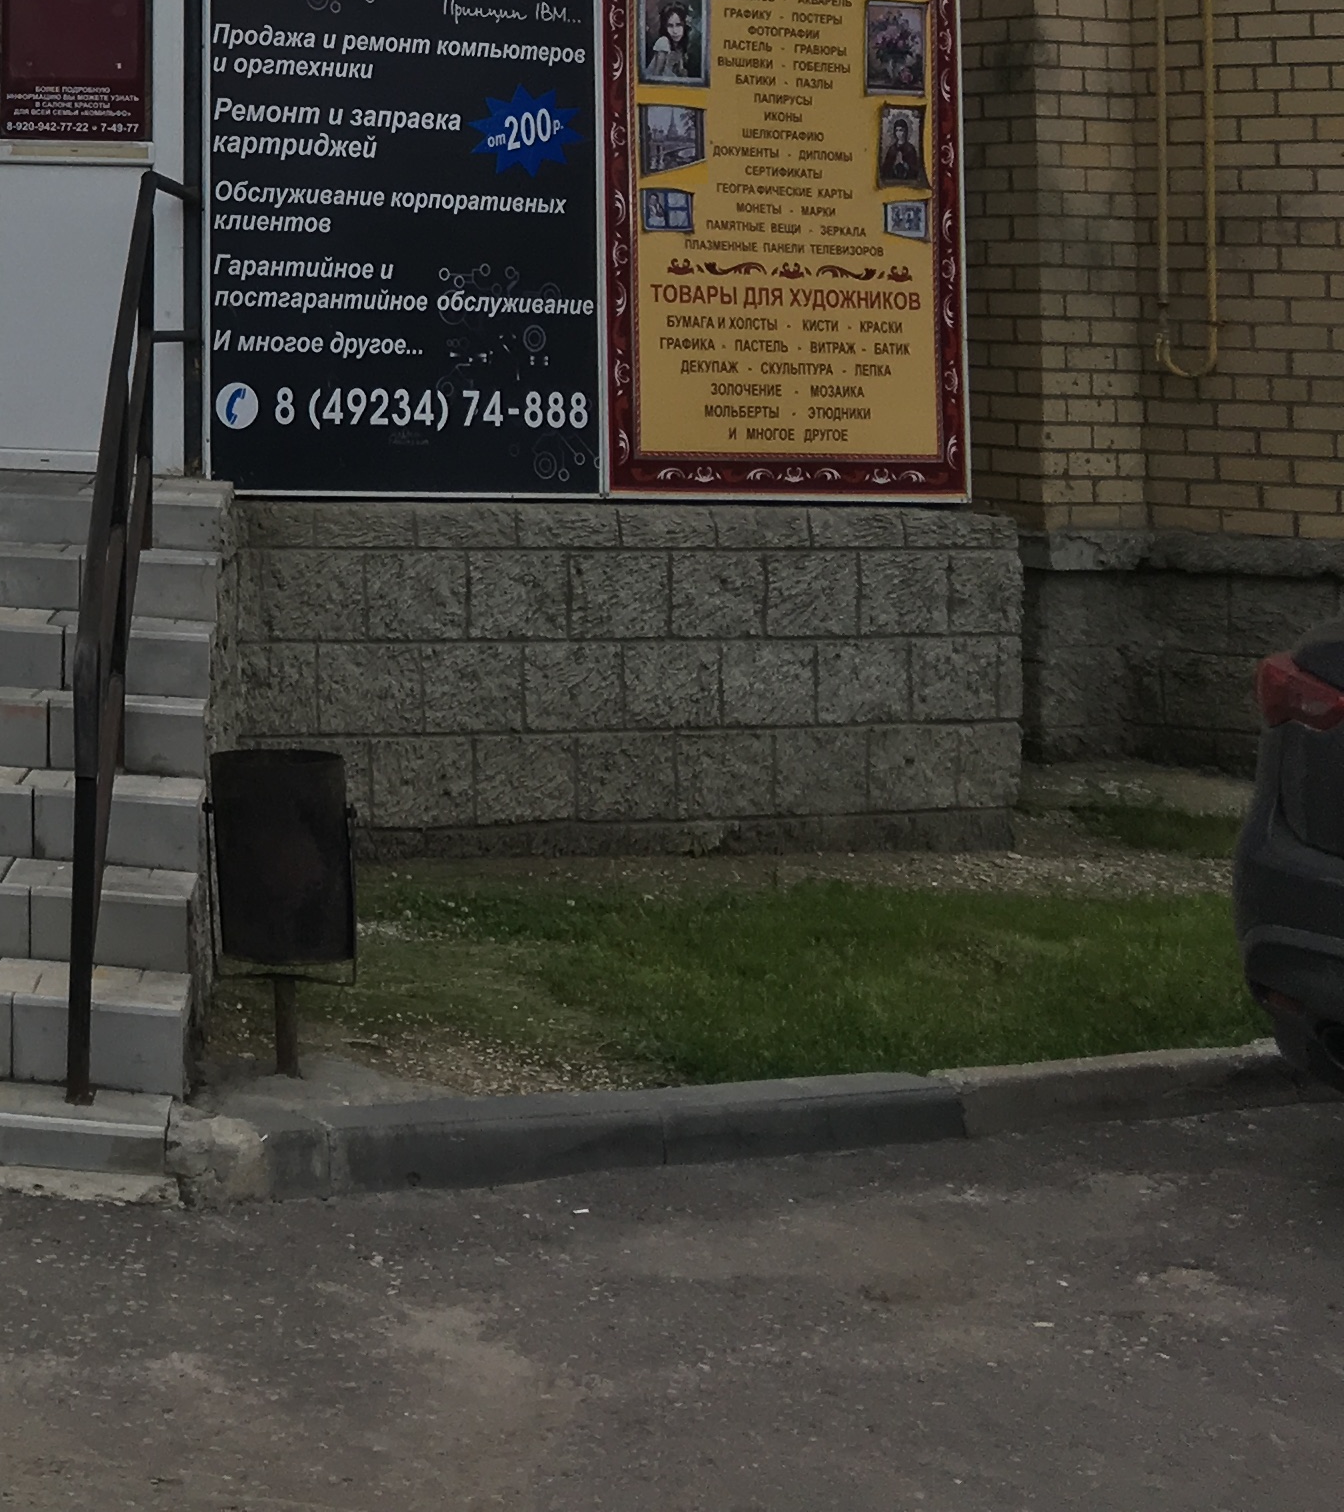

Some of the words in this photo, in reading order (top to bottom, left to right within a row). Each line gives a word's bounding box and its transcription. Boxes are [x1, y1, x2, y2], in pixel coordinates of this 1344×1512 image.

[723, 8, 772, 20] ГРАФИКУ
[792, 12, 843, 25] ПОСТЕРЫ
[748, 25, 820, 39] ФОТОГРАФИИ
[212, 23, 315, 49] Продажа
[323, 33, 337, 49] и
[341, 34, 431, 55] ремонт
[437, 40, 586, 67] компьютеров
[723, 39, 773, 52] ПАСТЕЛЬ
[794, 44, 847, 57] ГРАВЮРЫ
[213, 56, 227, 72] и
[234, 59, 374, 80] оргтехники
[717, 56, 774, 69] ВЫШИВКИ
[793, 60, 851, 74] ГОБЕЛЕНЫ
[735, 74, 776, 86] БАТИКИ
[795, 77, 833, 89] ПАЗЛЫ
[753, 92, 813, 106] ПАПИРУСЫ
[213, 97, 321, 125] Ремонт
[328, 108, 344, 126] и
[349, 109, 462, 132] заправка
[764, 111, 803, 123] ИКОНЫ
[6, 121, 89, 133] 8-920-942-77-22
[100, 122, 140, 133] 7-49-77
[742, 128, 824, 142] ШЕЛКОГРАФИЮ
[213, 133, 378, 161] картриджей
[712, 145, 780, 159] ДОКУМЕНТЫ
[798, 149, 853, 162] ДИПЛОМЫ
[744, 165, 823, 179] СЕРТИФИКАТЫ
[214, 180, 385, 208] Обслуживание
[390, 190, 567, 215] корпоративных
[716, 182, 813, 198] ГЕОГРАФИЧЕСКИЕ
[817, 187, 853, 200] КАРТЫ
[736, 202, 782, 215] МОНЕТЫ
[801, 205, 836, 217] МАРКИ
[213, 212, 332, 234] клиентов
[706, 220, 766, 233] ПАМЯТНЫЕ
[770, 223, 801, 235] ВЕЩИ
[820, 225, 867, 238] ЗЕРКАЛА
[684, 239, 758, 253] ПЛАЗМЕННЫЕ
[763, 242, 805, 254] ПАНЕЛИ
[811, 244, 884, 257] ТЕЛЕВИЗОРОВ
[213, 253, 375, 281] Гарантийное
[379, 263, 394, 279] и
[214, 288, 428, 314] постгарантийное
[436, 291, 595, 318] обслуживание
[650, 284, 737, 305] ТОВАРЫ
[743, 287, 784, 309] ДЛЯ
[789, 288, 921, 311] ХУДОЖНИКОВ
[666, 315, 715, 329] БУМАГА
[717, 316, 726, 329] И
[728, 316, 778, 331] ХОЛСТЫ
[802, 319, 839, 332] КИСТИ
[859, 320, 903, 334] КРАСКИ
[213, 329, 232, 350] И
[237, 332, 324, 354] многое
[329, 331, 424, 359] другое...
[659, 337, 715, 351] ГРАФИКА
[734, 339, 788, 353] ПАСТЕЛЬ
[810, 341, 856, 355] ВИТРАЖ
[874, 343, 910, 356] БАТИК
[680, 360, 739, 375] ДЕКУПАЖ
[760, 361, 834, 376] СКУЛЬПТУРА
[854, 364, 892, 377] ЛЕПКА
[710, 383, 783, 397] ЗОЛОЧЕНИЕ
[810, 385, 865, 398] МОЗАИКА
[274, 387, 296, 426] 8
[308, 388, 449, 432] (49234)
[462, 390, 589, 429] 74-888
[704, 405, 779, 419] МОЛЬБЕРТЫ
[807, 406, 871, 421] ЭТЮДНИКИ
[728, 427, 737, 440] И
[746, 427, 795, 442] МНОГОЕ
[803, 428, 849, 443] ДРУГОЕ
